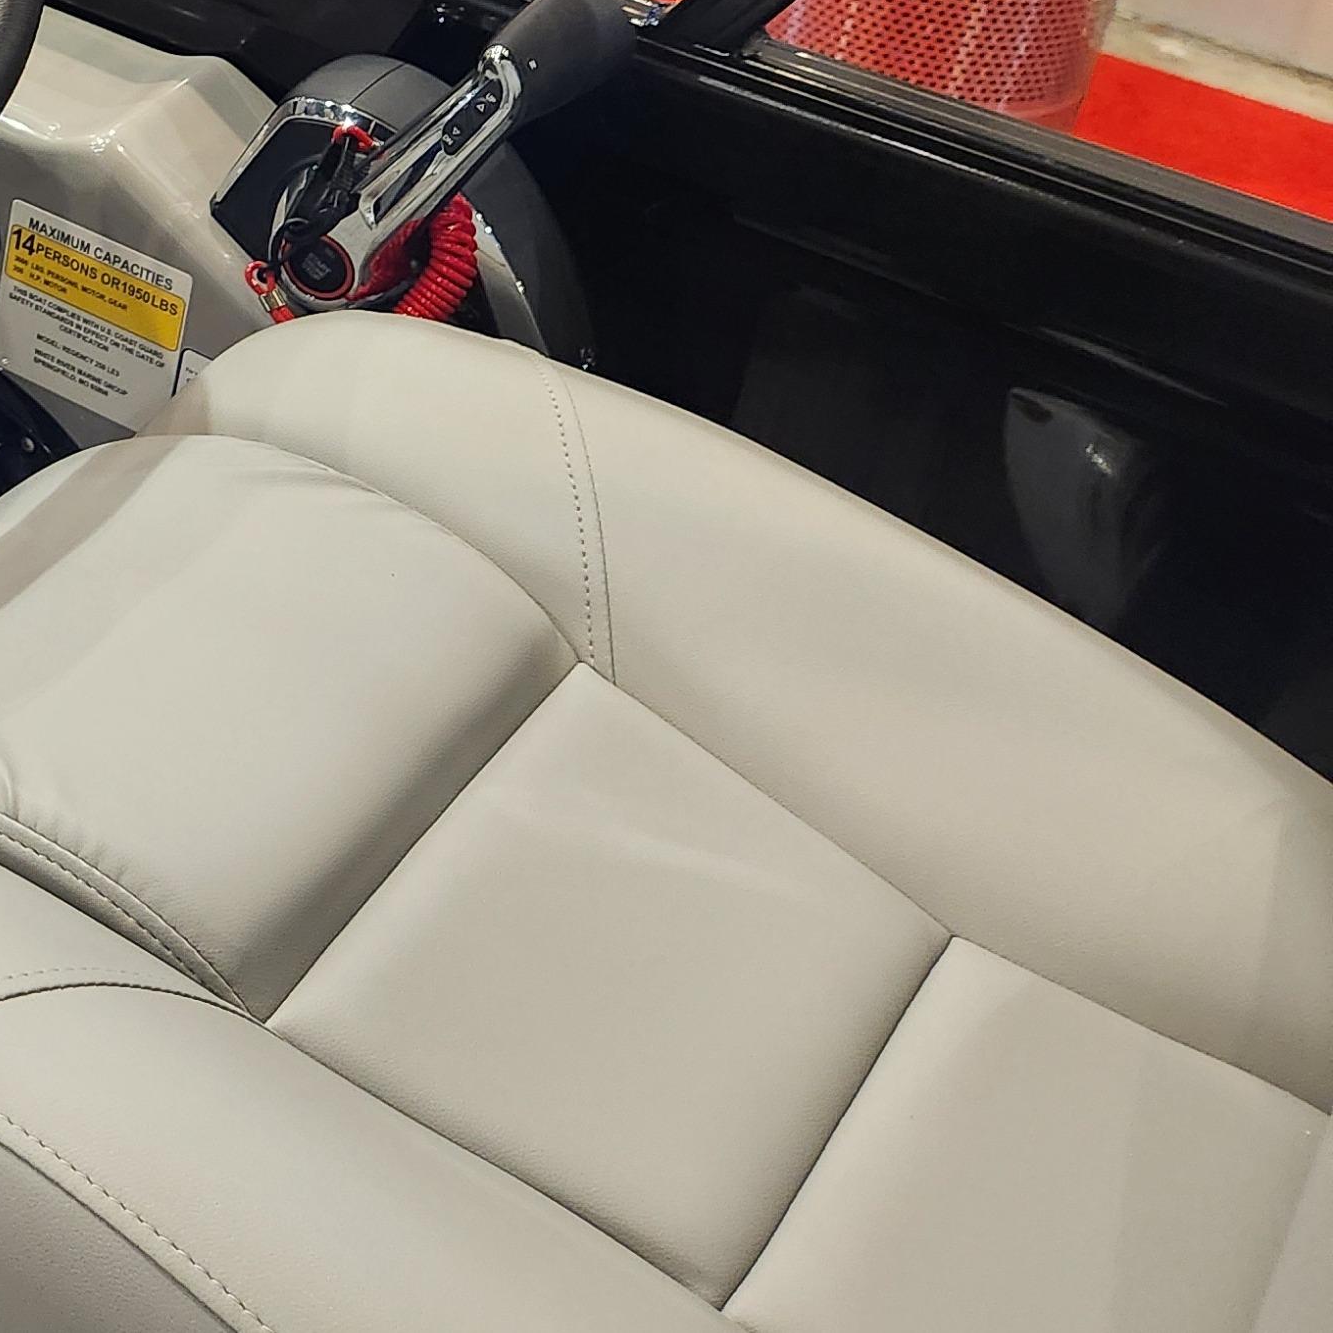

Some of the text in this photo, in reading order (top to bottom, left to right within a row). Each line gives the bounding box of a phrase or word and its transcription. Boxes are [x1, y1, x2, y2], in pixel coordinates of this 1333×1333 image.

[10, 225, 178, 317] 14 PERSONS OR 1950 LBS
[28, 216, 173, 291] MAXIMUM CAPACITIES
